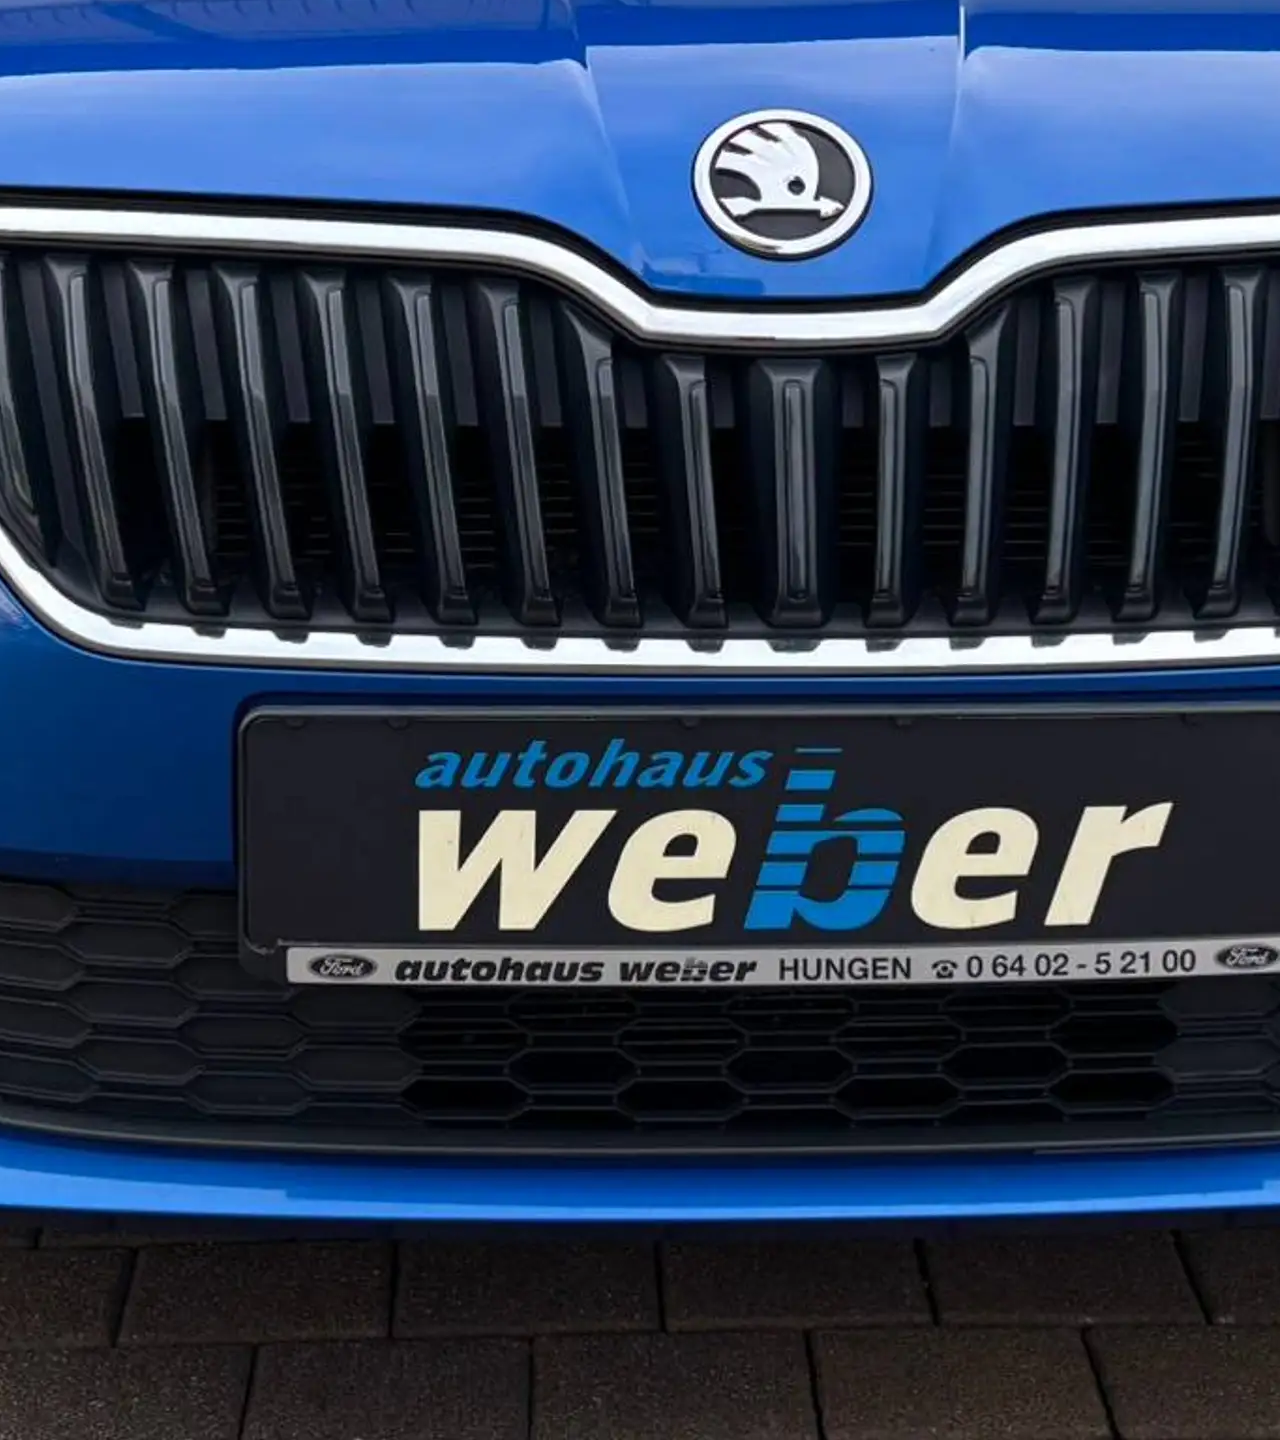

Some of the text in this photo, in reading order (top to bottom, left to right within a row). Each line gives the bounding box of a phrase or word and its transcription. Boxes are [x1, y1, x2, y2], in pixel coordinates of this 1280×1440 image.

[414, 737, 774, 790] autohaus
[416, 746, 1175, 933] weber
[394, 956, 605, 983] autohaus
[619, 956, 758, 983] weber
[778, 957, 913, 982] HUNGEN
